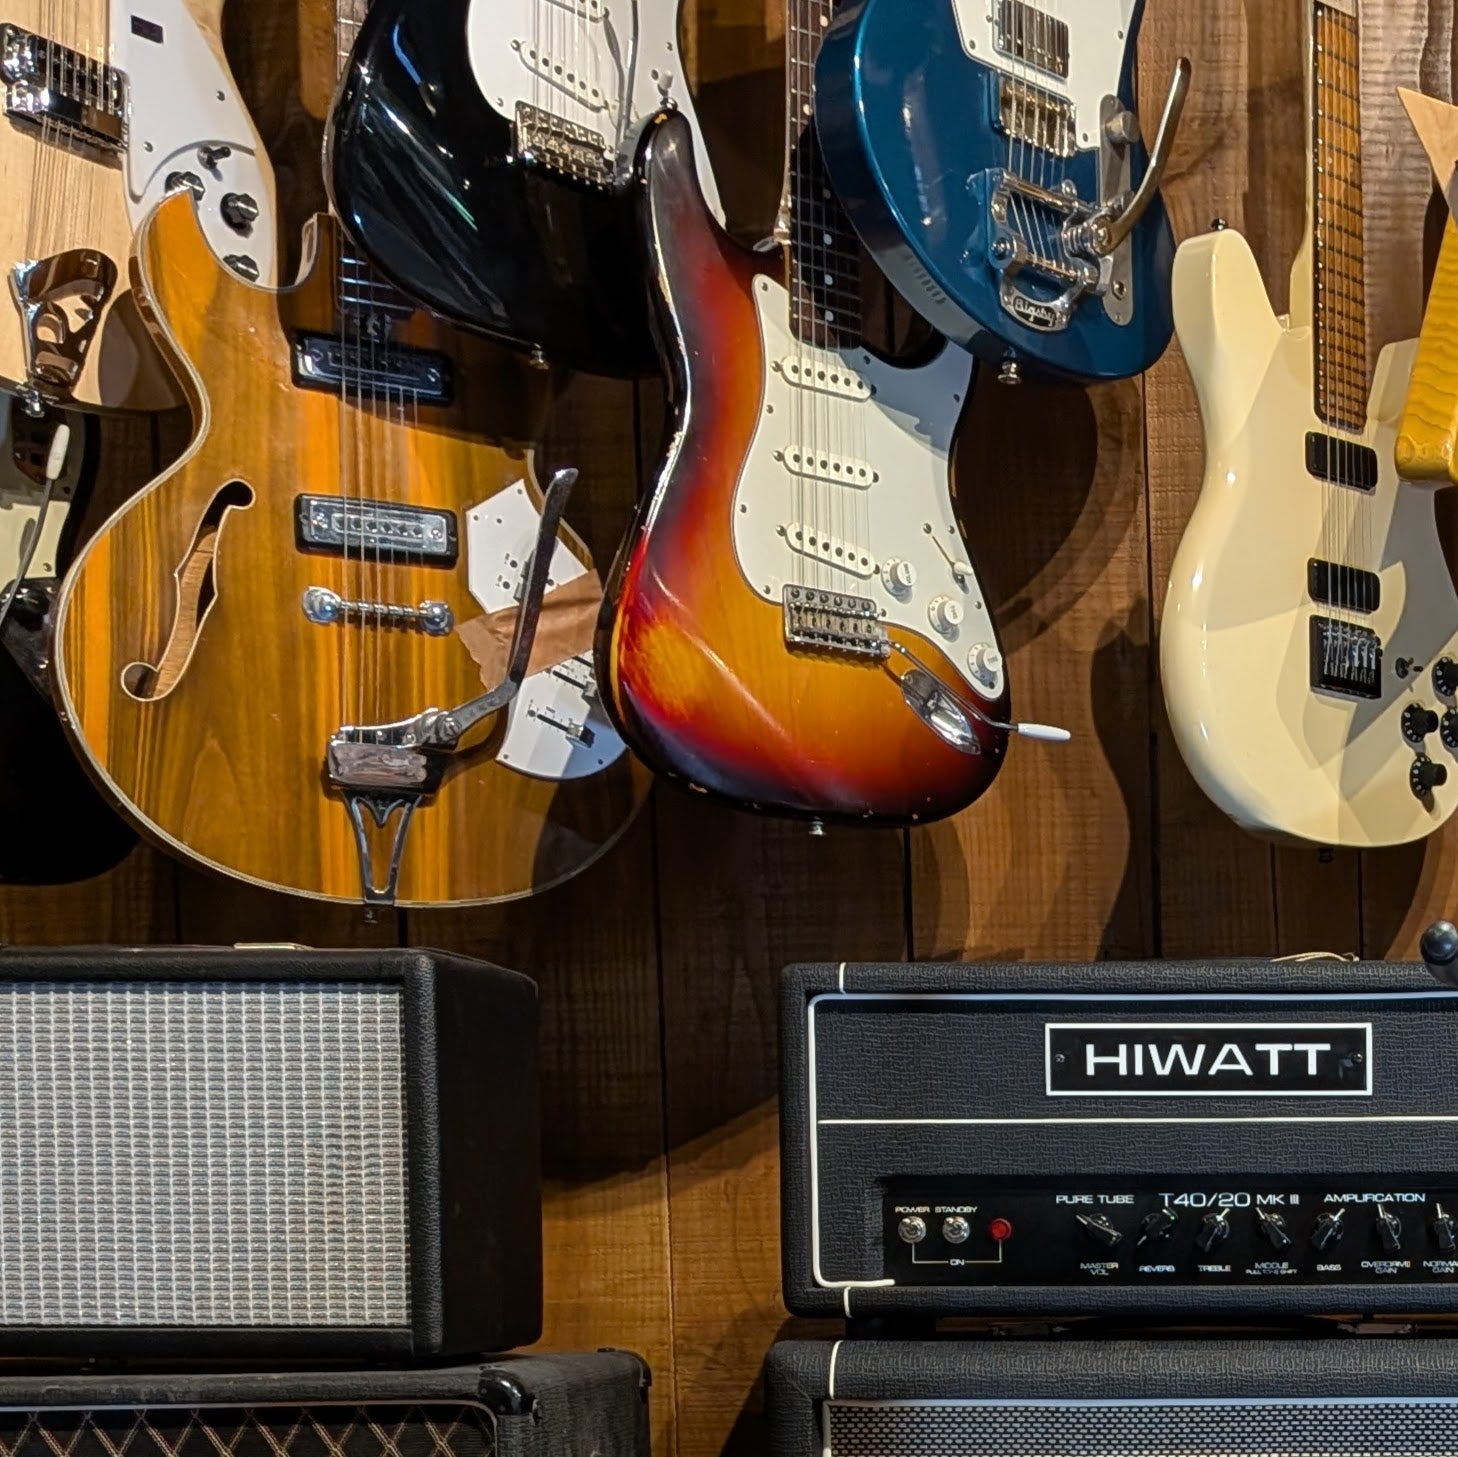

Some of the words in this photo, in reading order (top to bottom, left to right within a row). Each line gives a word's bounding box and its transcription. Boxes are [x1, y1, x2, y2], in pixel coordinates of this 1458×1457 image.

[1014, 298, 1056, 327] Bigsby
[1086, 1043, 1331, 1076] HIWATT
[1055, 1194, 1094, 1204] PURE
[1097, 1194, 1135, 1204] TUBE
[1158, 1192, 1251, 1207] T40/20
[1256, 1194, 1285, 1205] MK
[1324, 1192, 1426, 1203] AMPLIFICATION
[1361, 1260, 1411, 1268] OVERDRIVE
